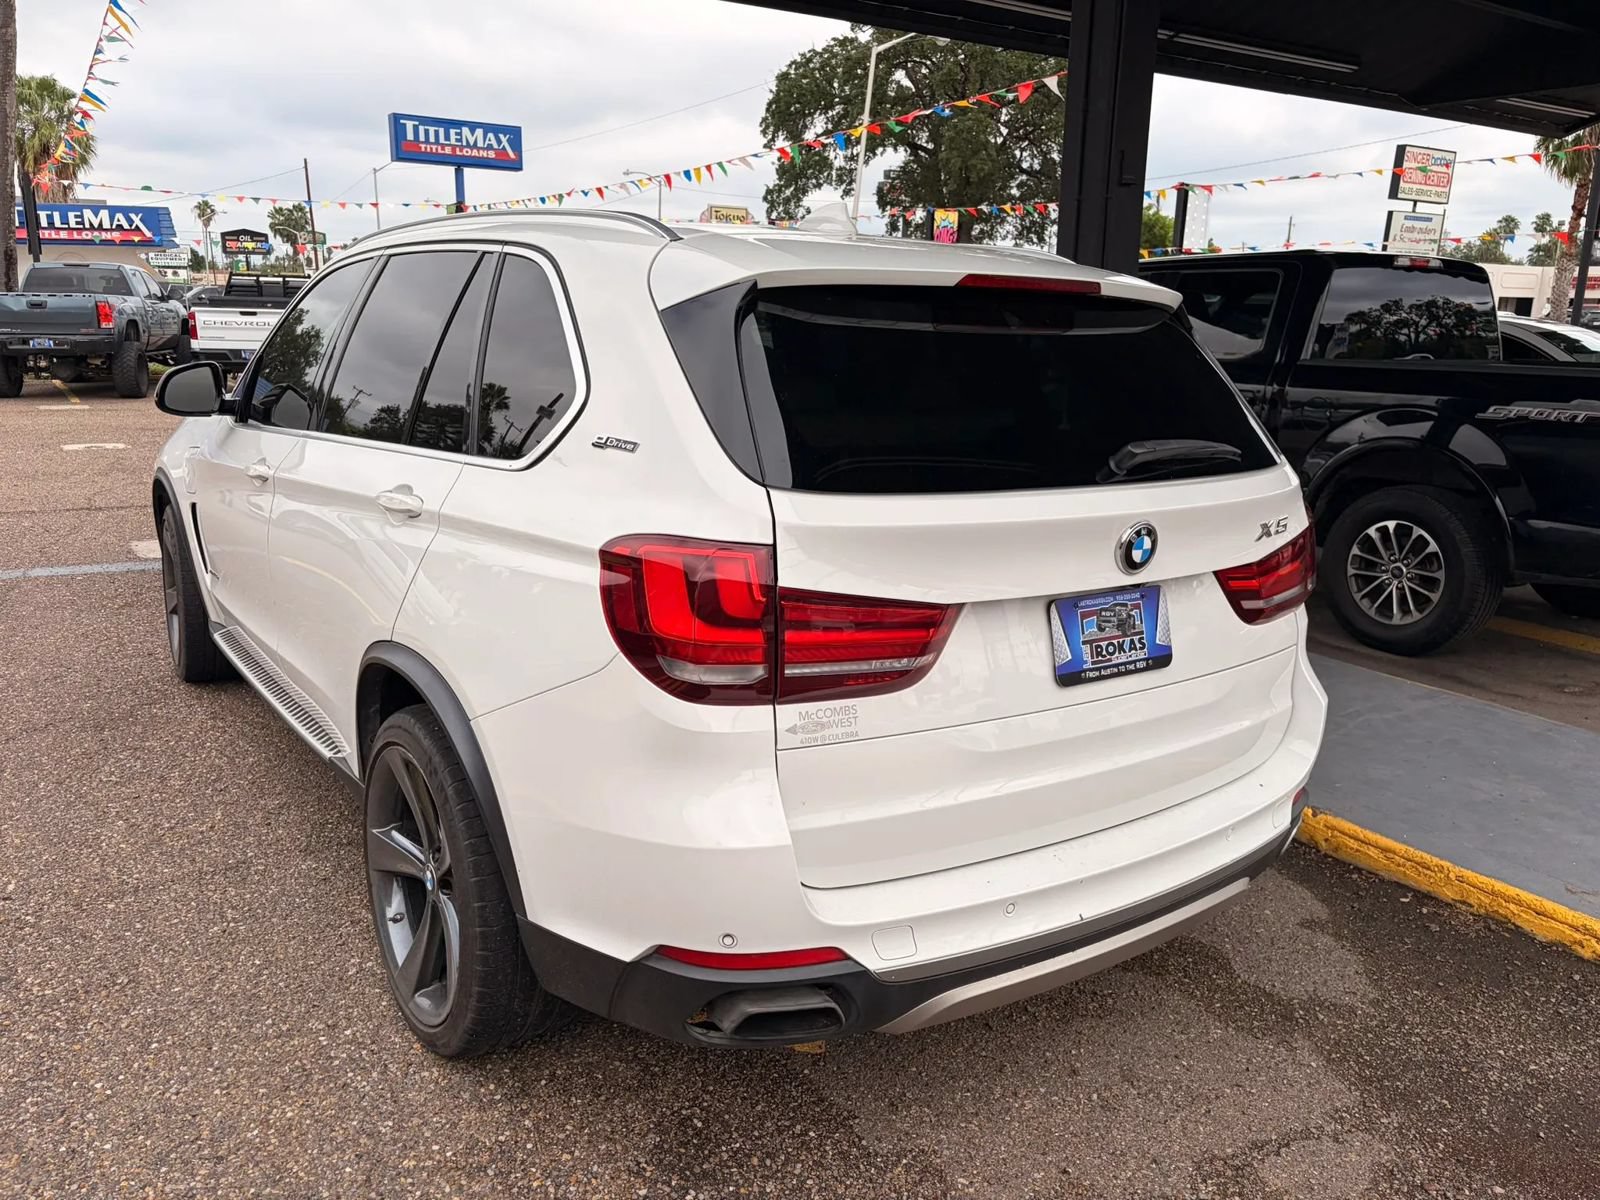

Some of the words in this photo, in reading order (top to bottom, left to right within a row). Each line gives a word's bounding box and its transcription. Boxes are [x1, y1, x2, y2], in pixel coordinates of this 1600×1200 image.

[419, 143, 452, 155] TITLE
[455, 147, 496, 159] LOANS
[1426, 171, 1449, 186] CENTER
[15, 206, 153, 238] TTLEMAX
[39, 230, 69, 239] ITLE
[203, 319, 274, 327] CHEVROL
[1475, 405, 1600, 424] SPORT
[1254, 515, 1289, 542] X5
[1082, 637, 1147, 660] TROKAS
[1086, 669, 1101, 679] FROM
[1126, 663, 1136, 671] THE
[798, 704, 858, 722] McCOMBS
[828, 715, 859, 729] WEST
